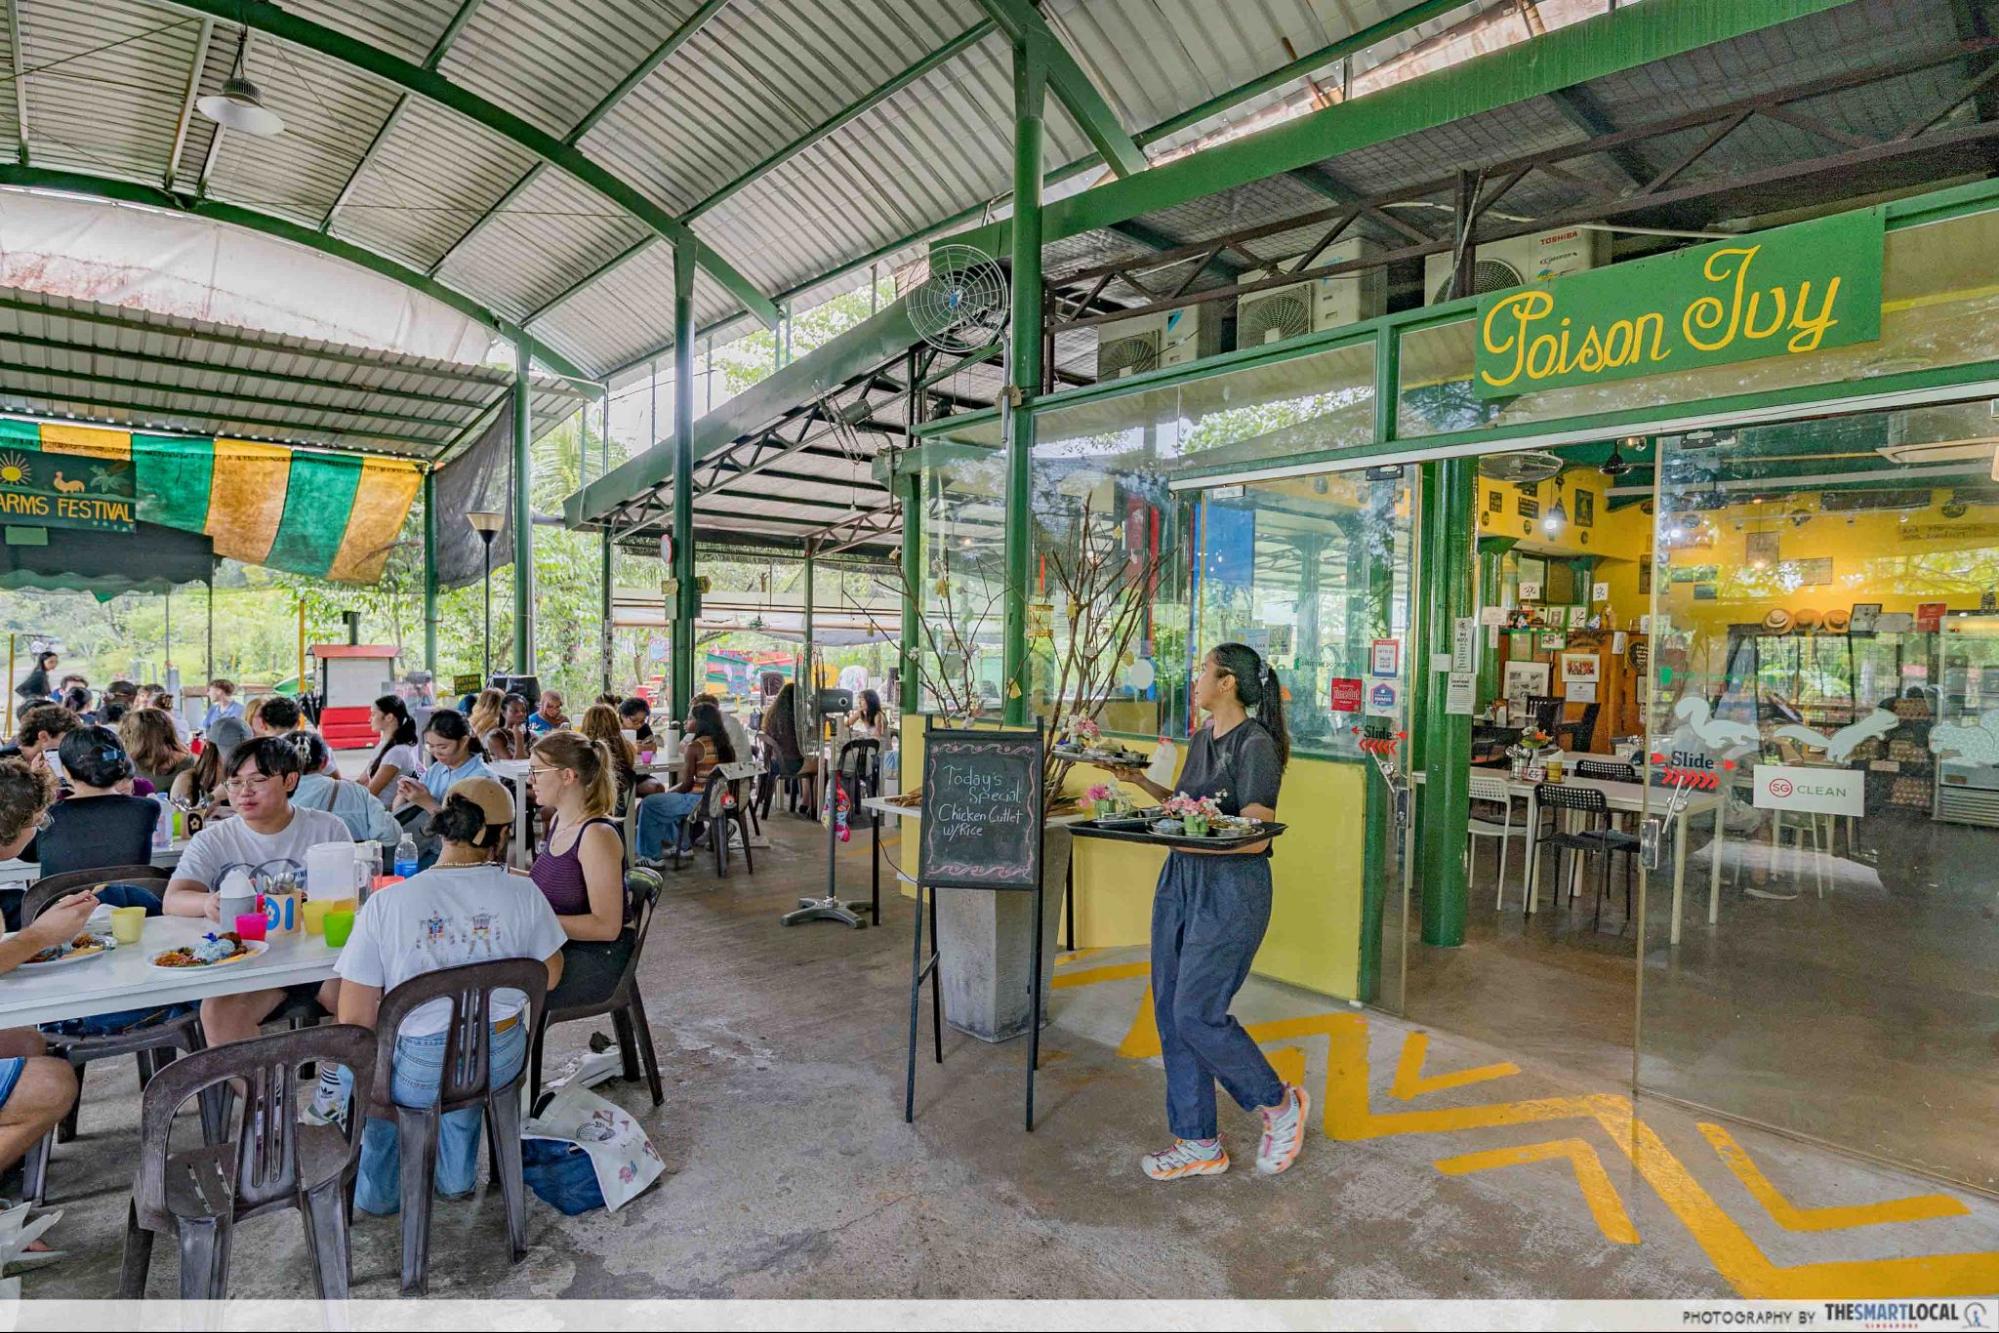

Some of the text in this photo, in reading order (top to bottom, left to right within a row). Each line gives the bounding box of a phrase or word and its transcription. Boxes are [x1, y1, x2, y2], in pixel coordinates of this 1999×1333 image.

[1540, 231, 1578, 245] TOSHIBA
[1481, 244, 1841, 387] Poison Ivy
[57, 497, 135, 523] FESTIVAL
[1363, 725, 1393, 740] Slide
[1671, 751, 1714, 770] Slide
[942, 765, 1003, 791] Today's
[1771, 781, 1847, 798] SG CLEAN
[938, 802, 1024, 824] Chicken Cutlet
